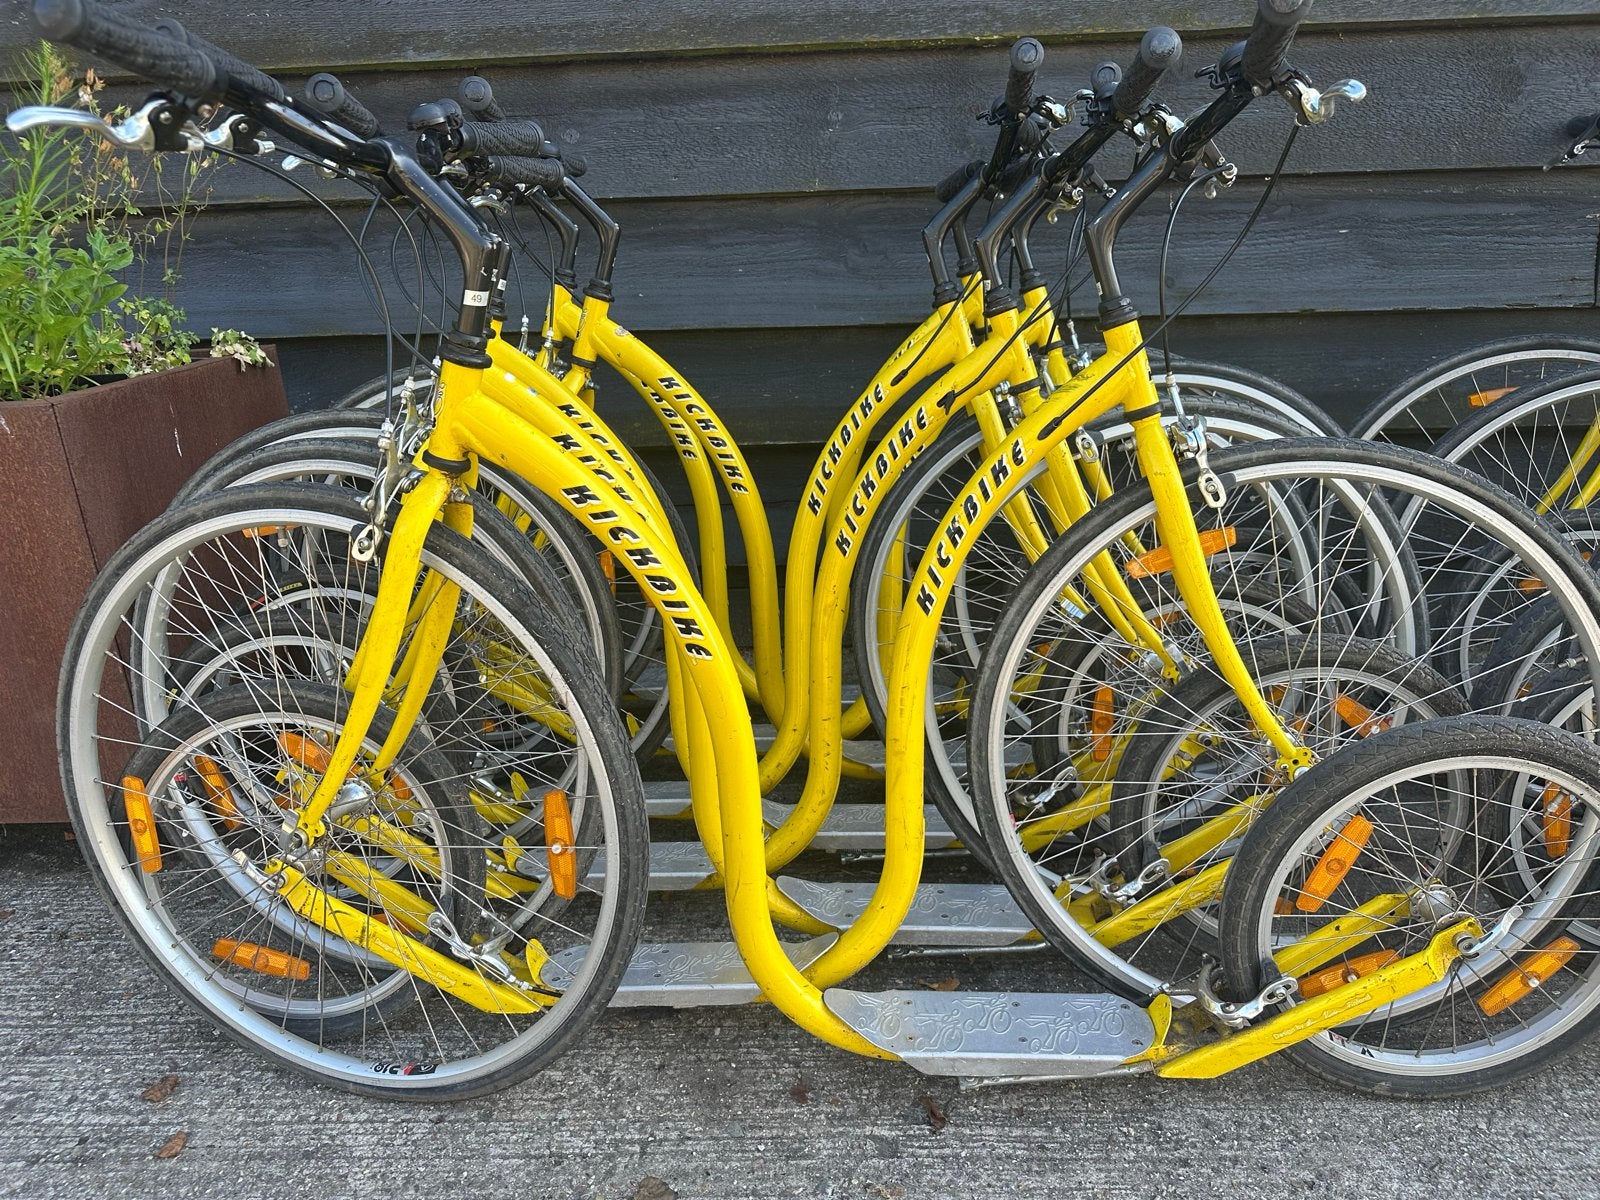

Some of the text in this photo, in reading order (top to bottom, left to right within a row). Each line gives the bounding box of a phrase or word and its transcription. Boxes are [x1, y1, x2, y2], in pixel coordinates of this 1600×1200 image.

[471, 294, 482, 303] 49
[657, 375, 749, 496] KICKBIKE
[806, 381, 884, 518] KICKBIKE
[835, 405, 931, 558] KICKBIKE
[560, 484, 713, 662] KICKBIKE
[915, 437, 1028, 618] KICKBIKE
